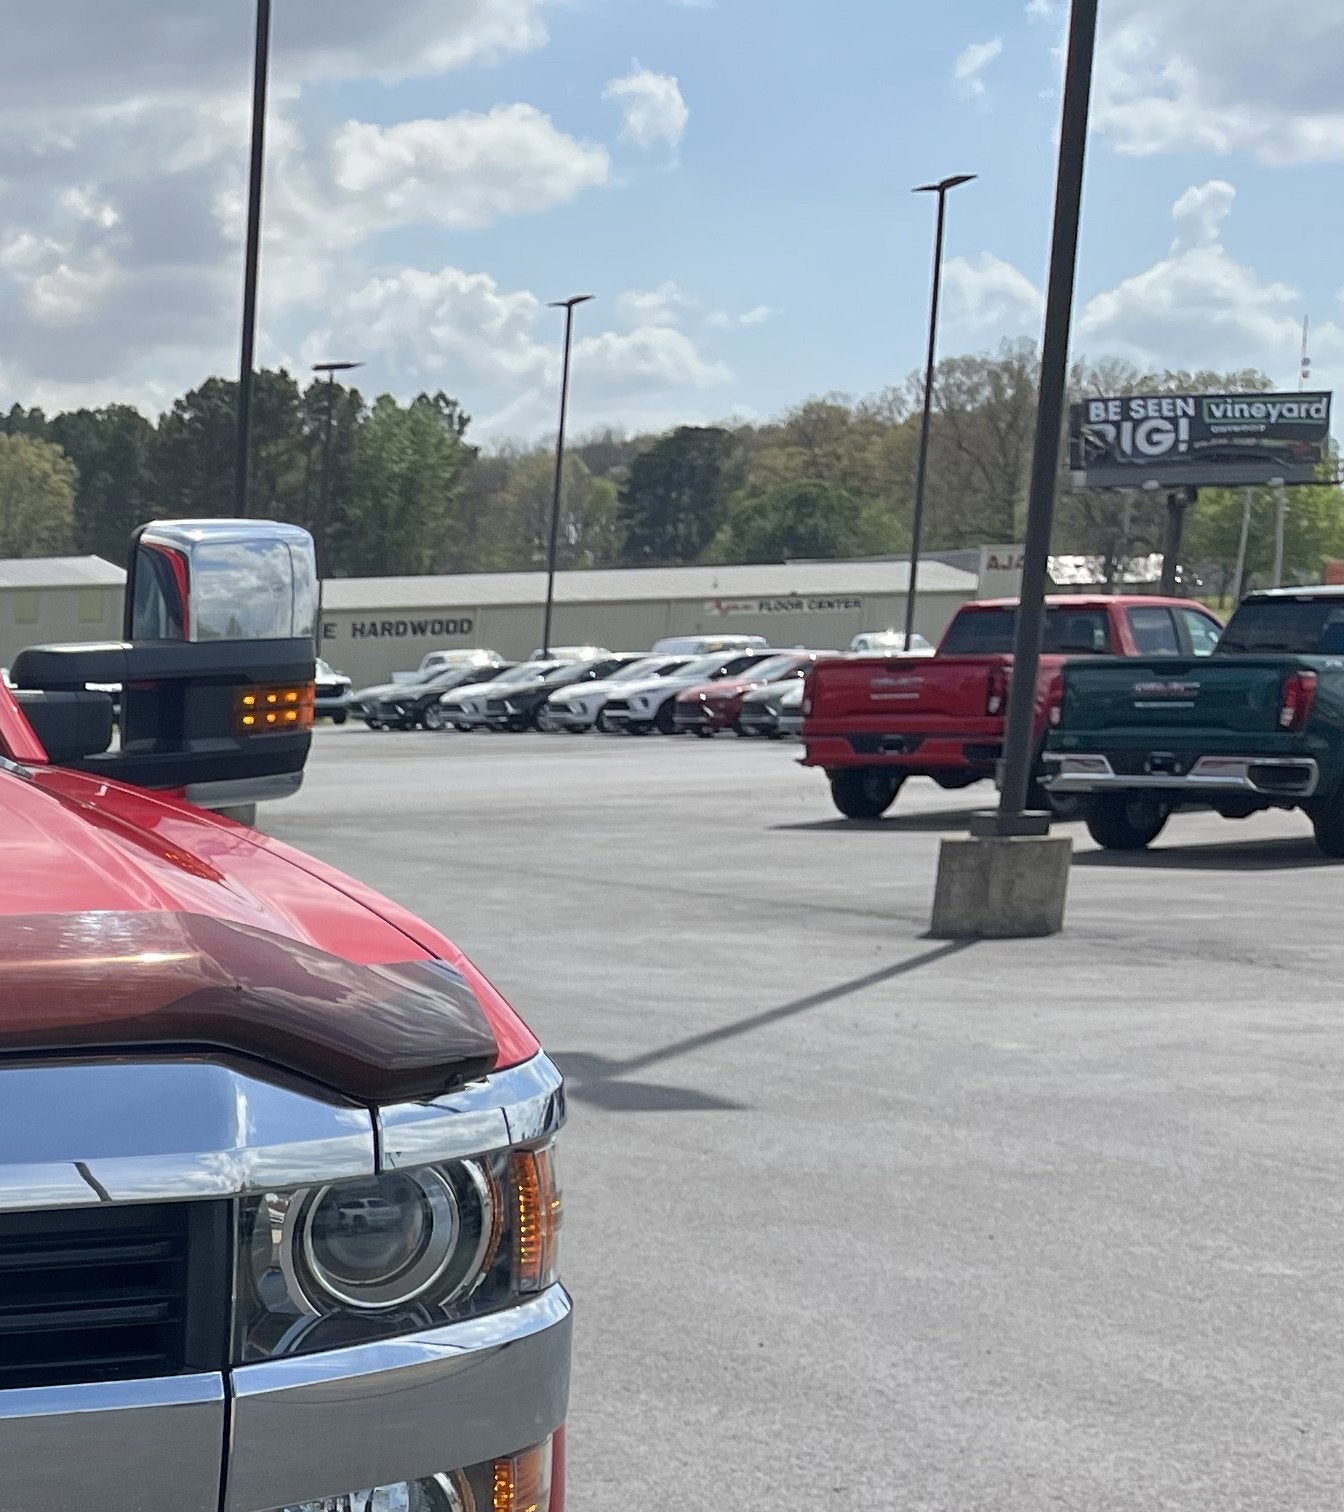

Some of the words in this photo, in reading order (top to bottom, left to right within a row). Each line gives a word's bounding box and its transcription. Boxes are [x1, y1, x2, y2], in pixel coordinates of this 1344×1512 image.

[1089, 400, 1122, 422] BE
[1128, 397, 1196, 420] SEEN
[1209, 397, 1328, 424] vineyard
[351, 618, 474, 639] HARDWOOD
